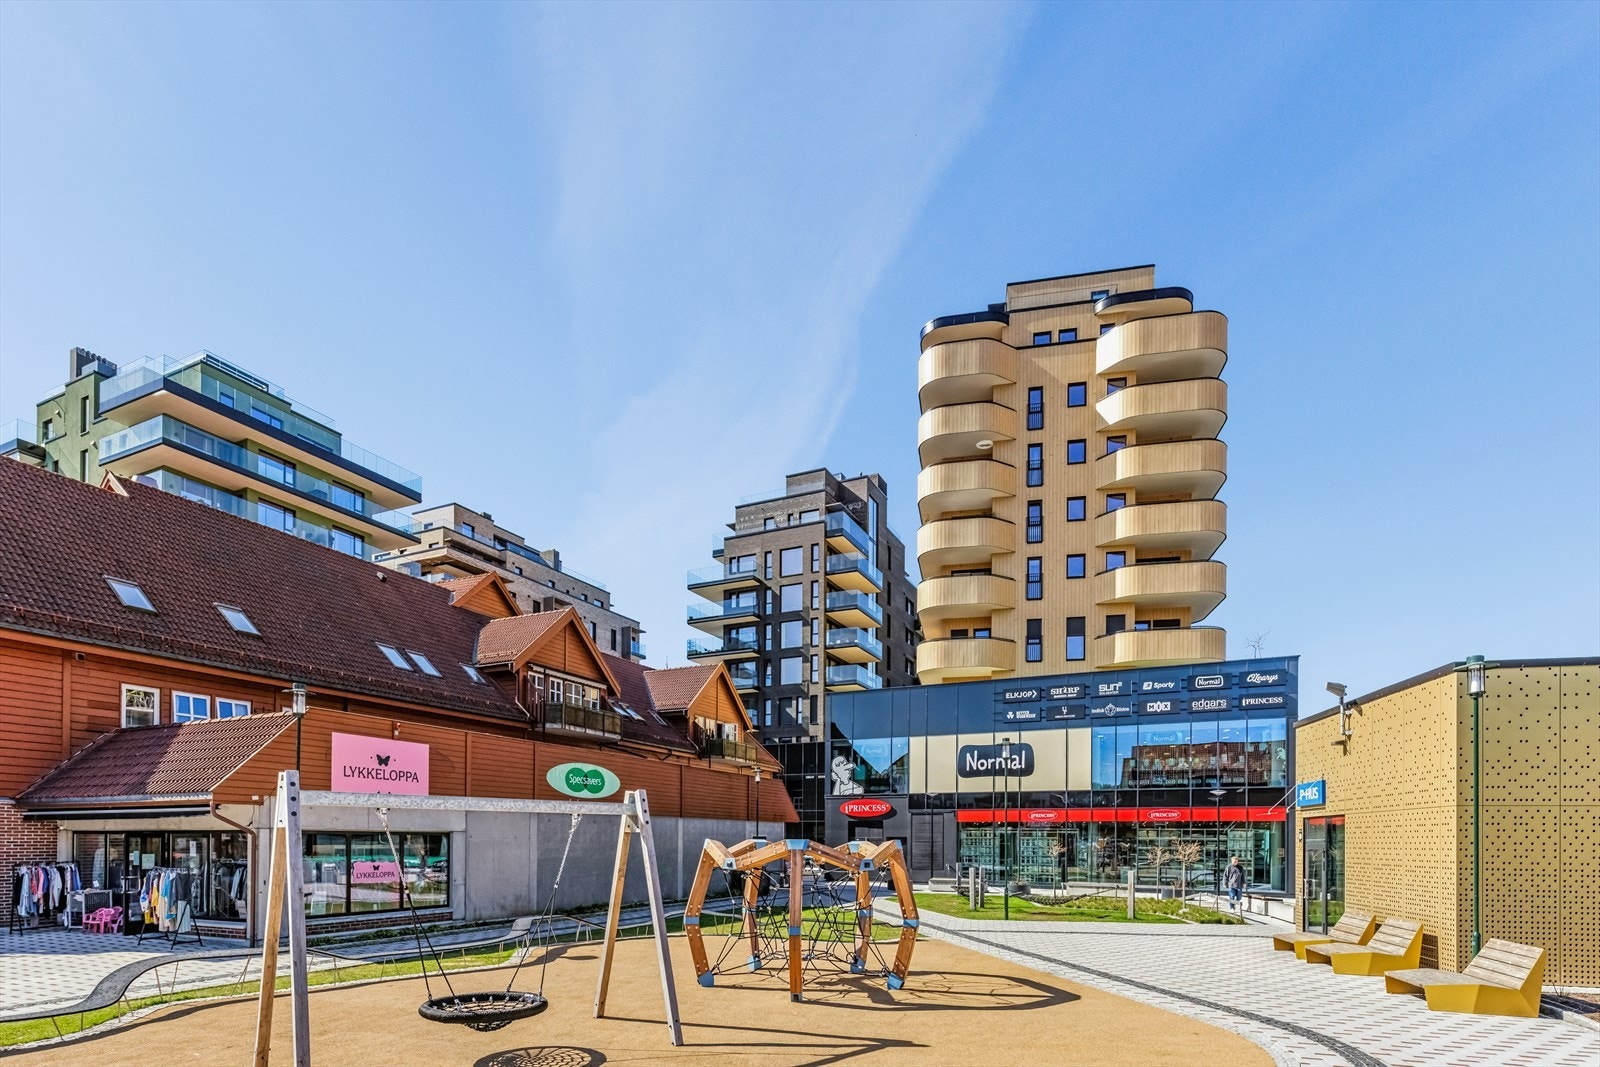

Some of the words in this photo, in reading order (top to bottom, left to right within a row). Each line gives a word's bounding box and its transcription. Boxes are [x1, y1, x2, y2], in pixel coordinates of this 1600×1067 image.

[1153, 681, 1175, 690] Sporty
[1198, 678, 1221, 686] Normal
[1147, 702, 1170, 711] MIX
[1192, 698, 1227, 709] edgars
[966, 750, 1025, 771] Normal
[343, 765, 419, 783] LYKKELOPPA
[568, 773, 602, 786] Specsavers
[356, 871, 396, 879] LYKKELOPPA
